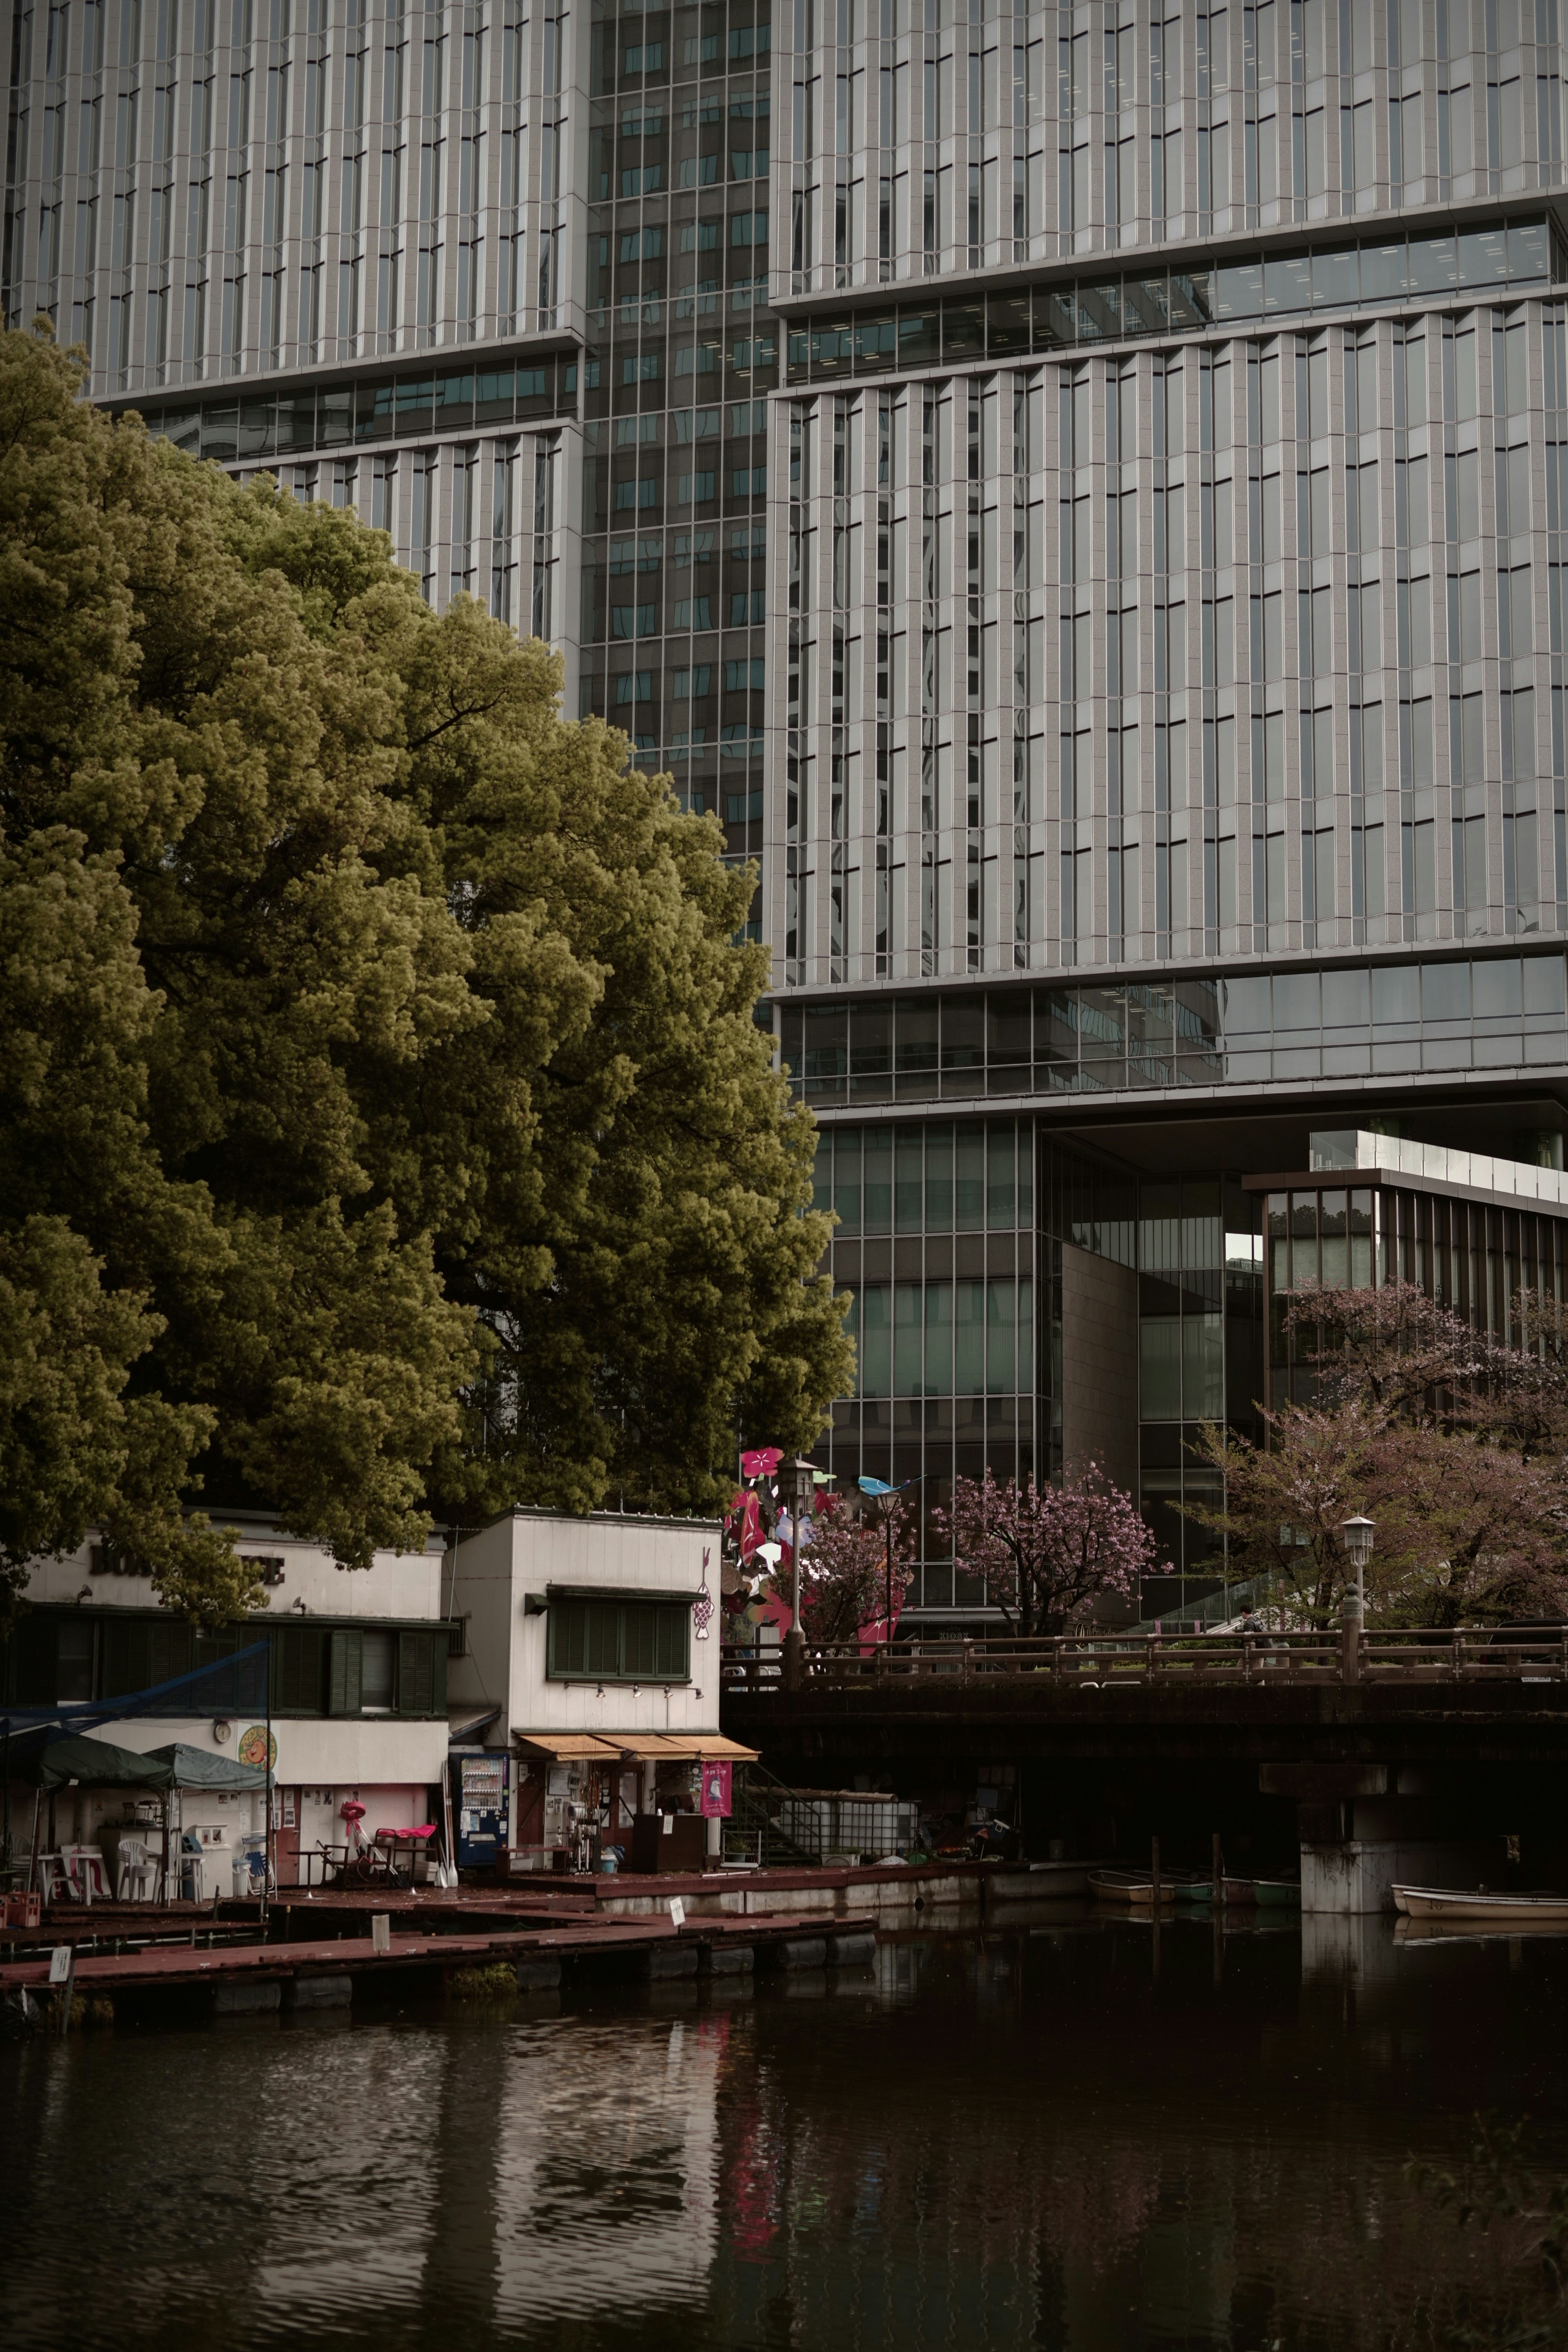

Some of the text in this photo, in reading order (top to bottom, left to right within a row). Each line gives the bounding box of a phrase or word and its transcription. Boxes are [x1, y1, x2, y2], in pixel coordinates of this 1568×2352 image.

[1237, 1883, 1251, 1893] 37
[1284, 1891, 1299, 1899] 17
[1426, 1900, 1443, 1910] 40
